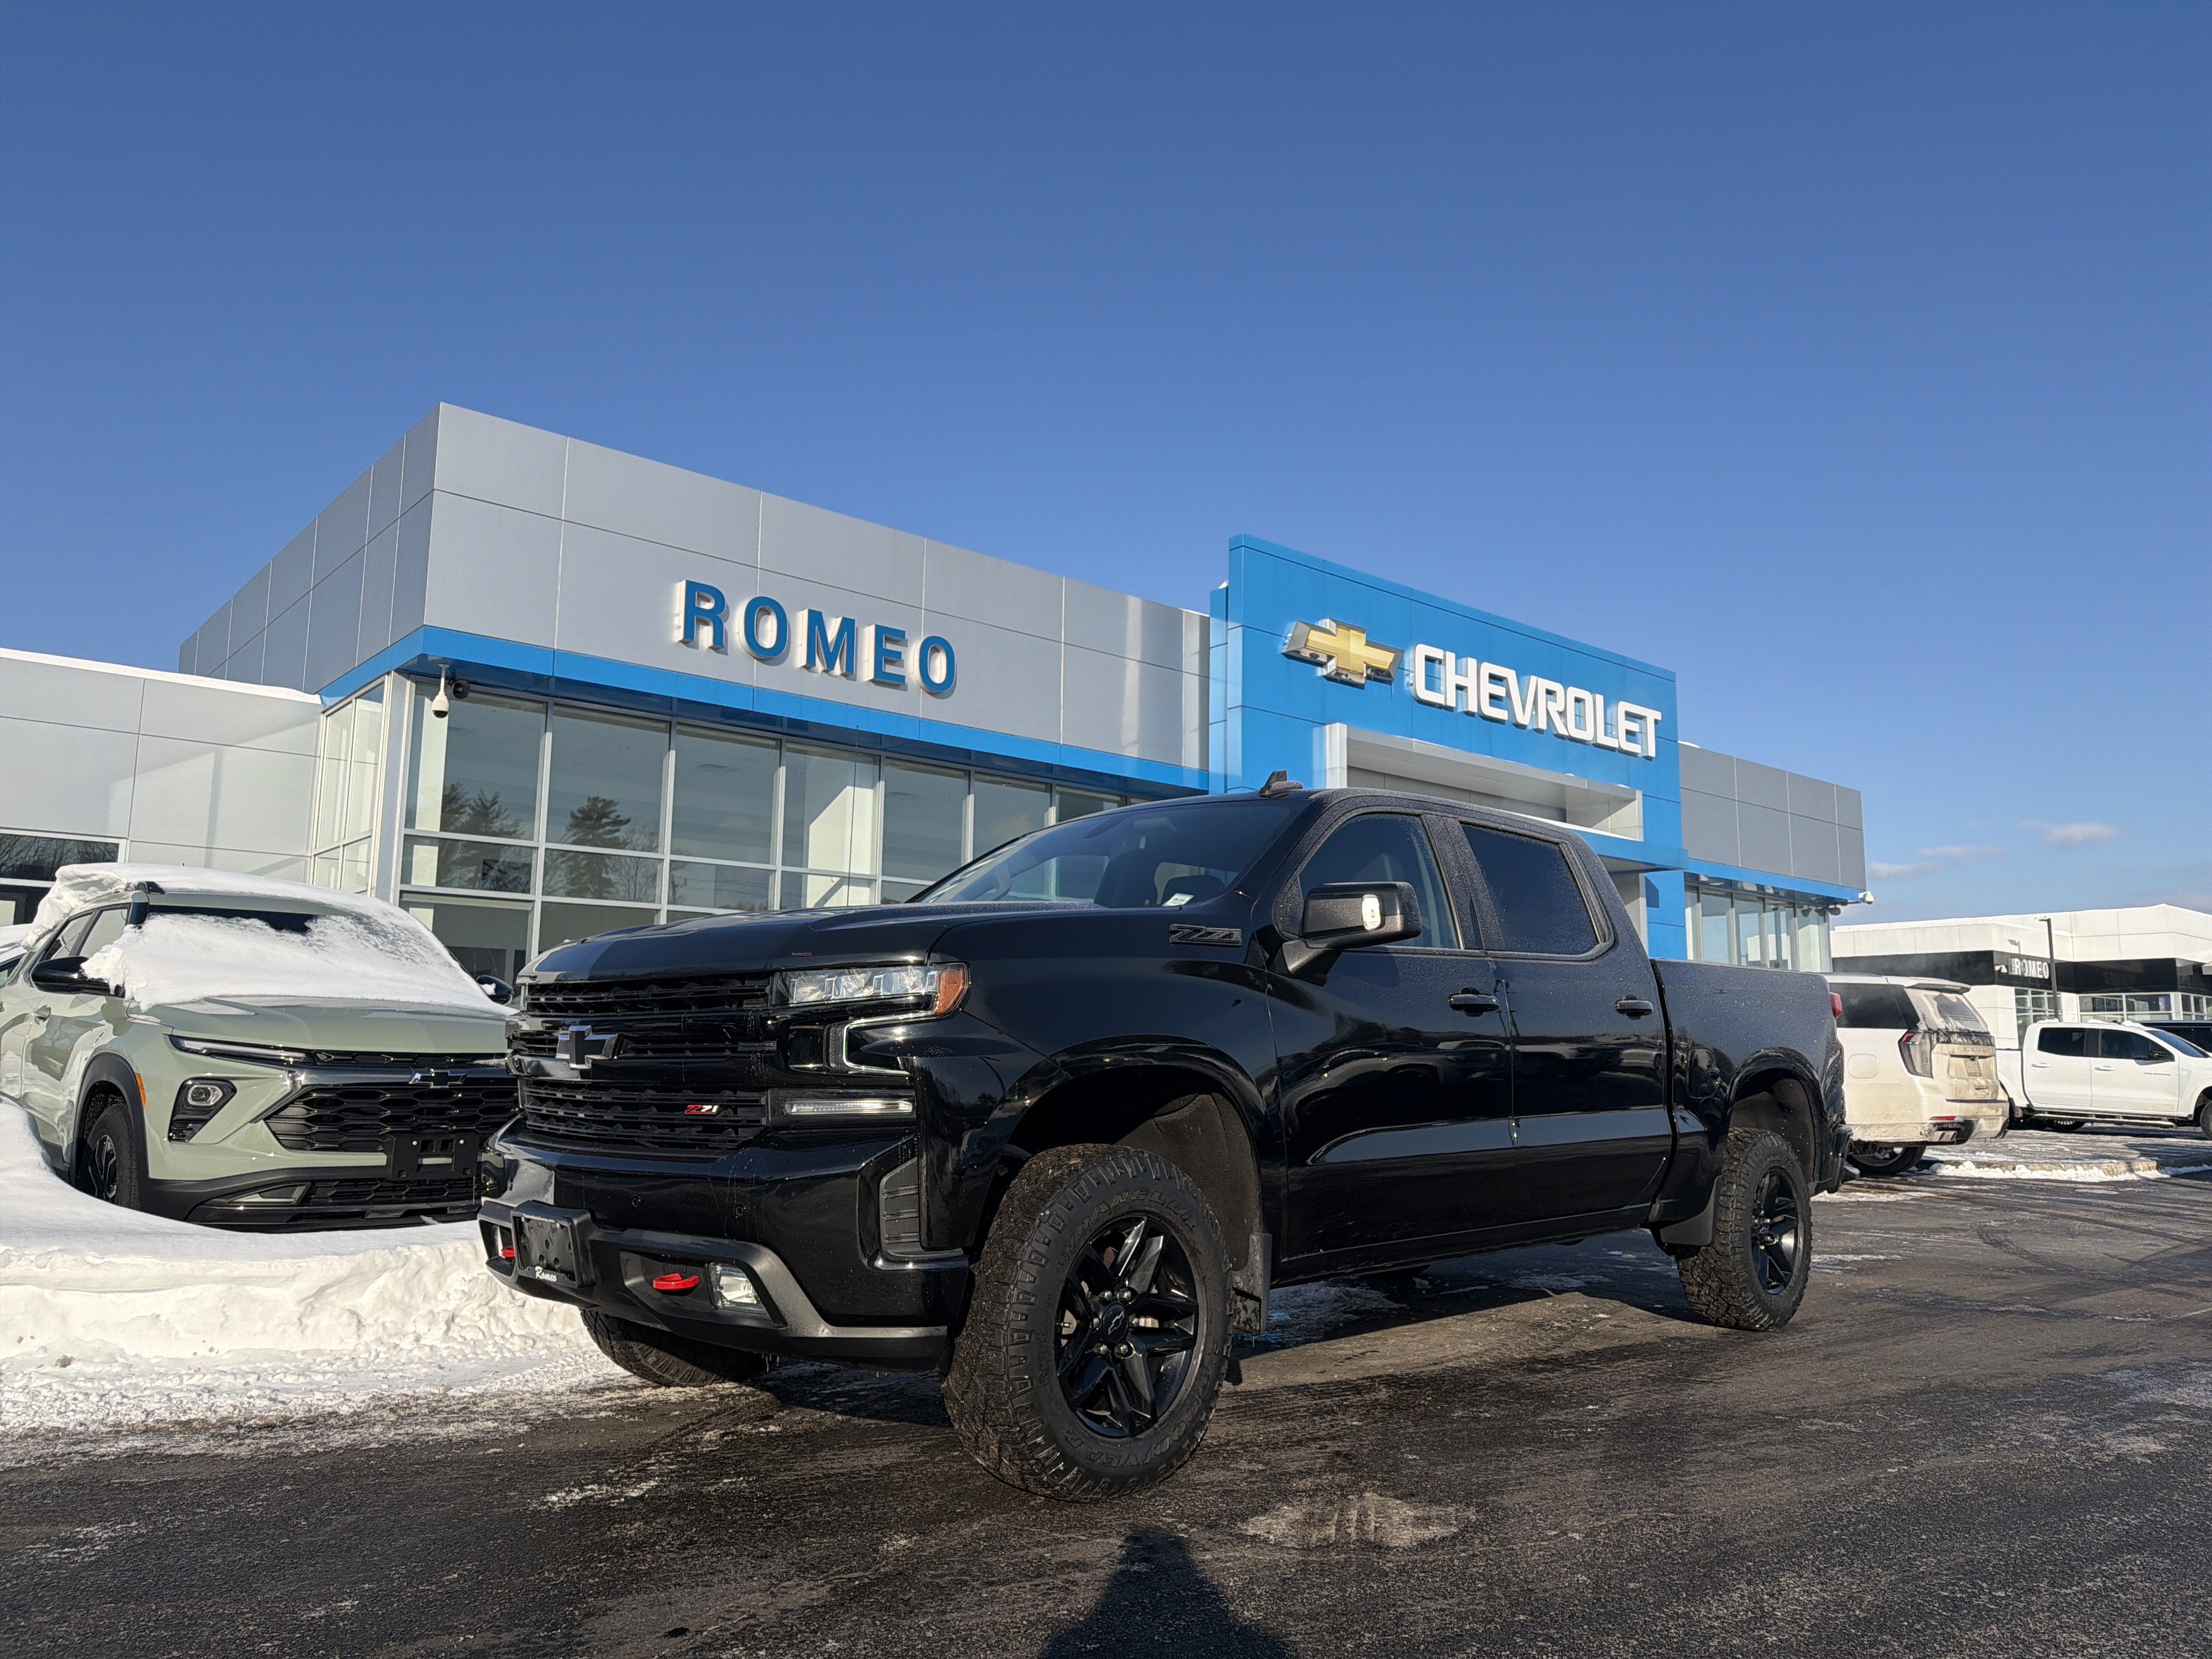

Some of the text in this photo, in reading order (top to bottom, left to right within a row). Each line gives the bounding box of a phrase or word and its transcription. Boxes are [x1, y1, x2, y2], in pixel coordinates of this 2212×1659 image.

[679, 579, 956, 694] ROMEO
[1413, 643, 1662, 758] CHEVROLET
[2012, 958, 2049, 979] ROMEO
[684, 1104, 720, 1115] Z71
